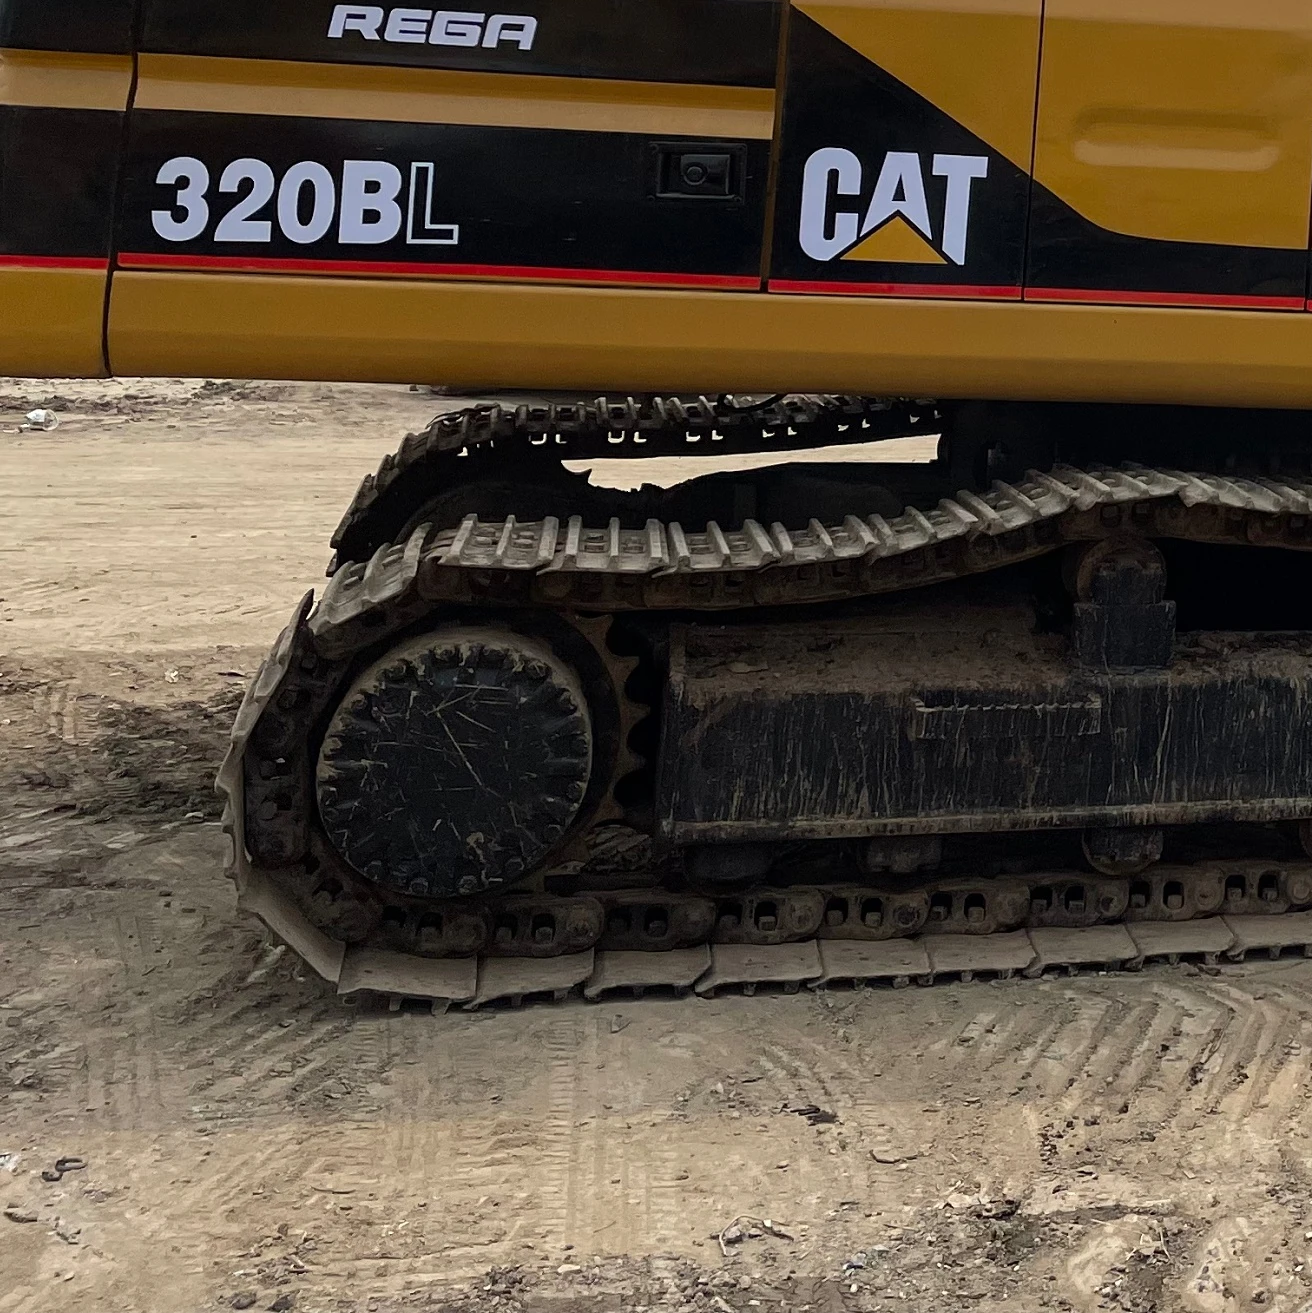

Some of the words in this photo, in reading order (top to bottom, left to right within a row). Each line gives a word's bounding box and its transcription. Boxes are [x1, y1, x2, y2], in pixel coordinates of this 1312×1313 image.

[327, 4, 538, 51] REGA
[151, 157, 459, 244] 320BL
[799, 147, 989, 266] CAT
